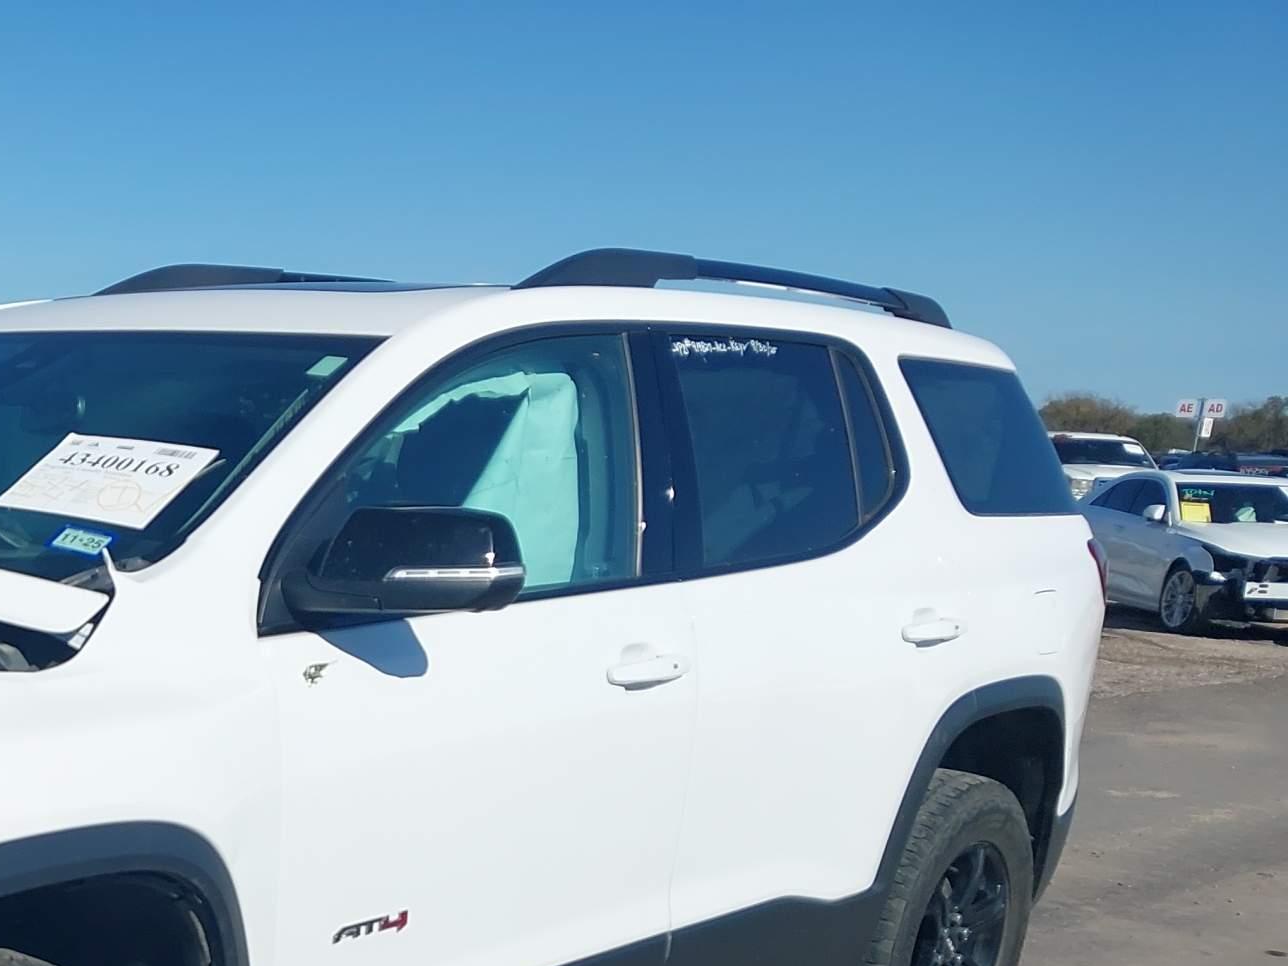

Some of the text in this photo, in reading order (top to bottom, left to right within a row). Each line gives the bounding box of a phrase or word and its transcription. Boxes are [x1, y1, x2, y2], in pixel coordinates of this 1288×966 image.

[1179, 403, 1194, 413] AE
[1208, 403, 1223, 413] AD
[58, 451, 180, 478] 43400168
[332, 909, 408, 944] AT4
